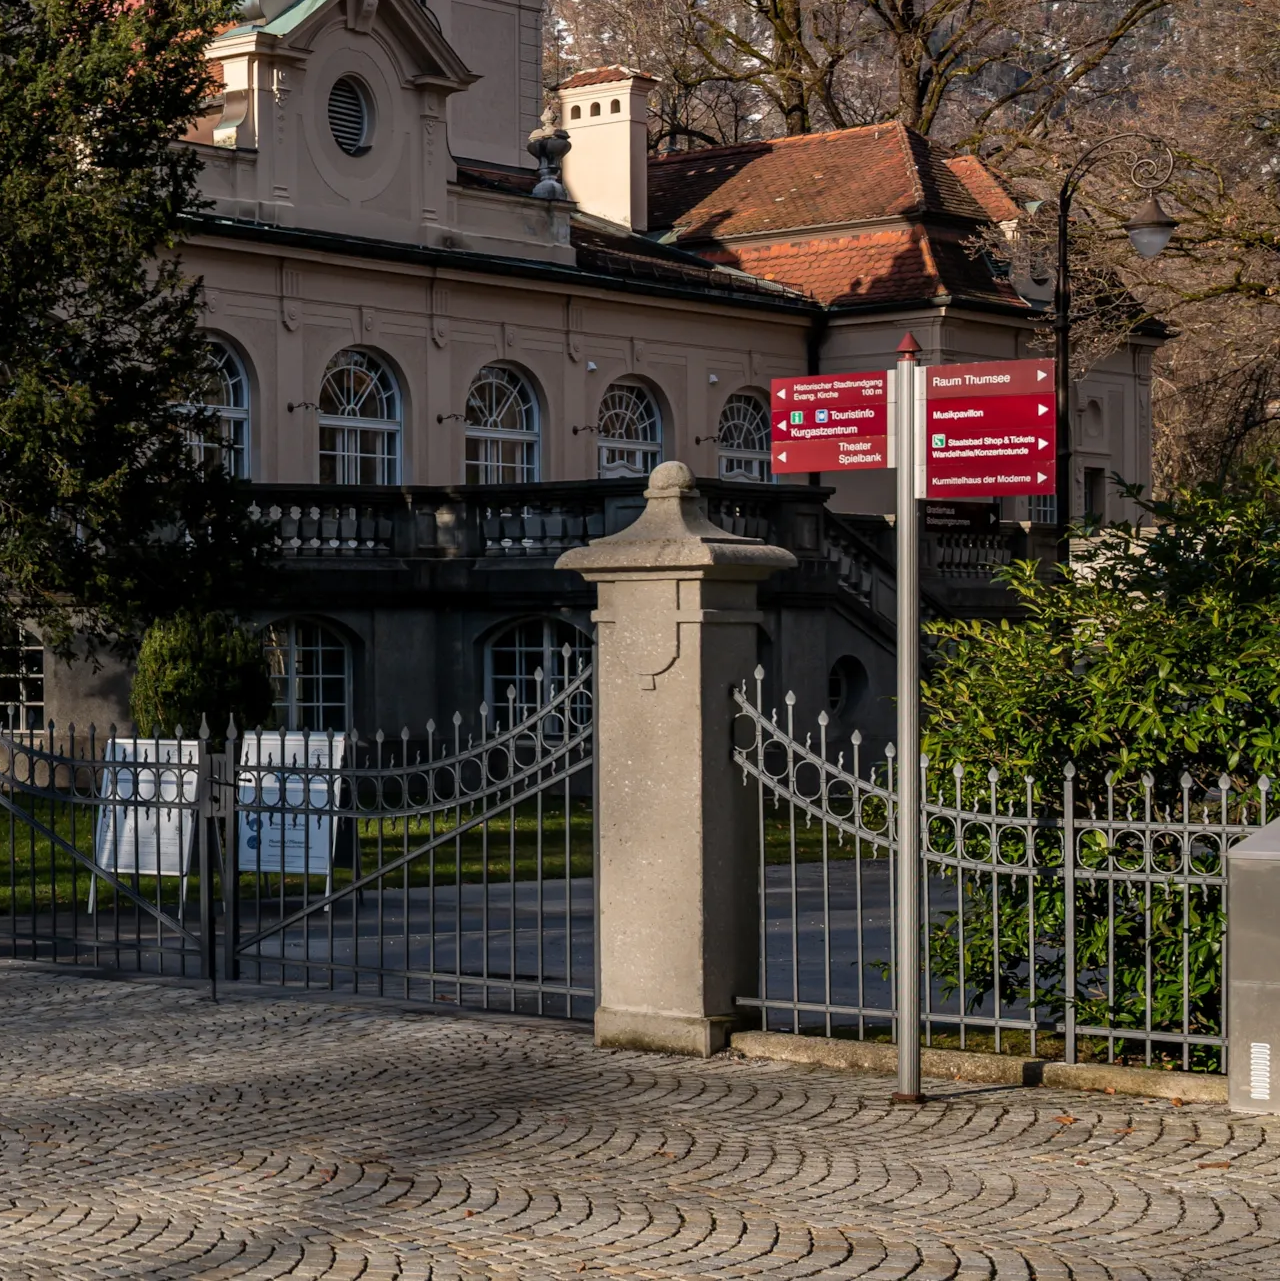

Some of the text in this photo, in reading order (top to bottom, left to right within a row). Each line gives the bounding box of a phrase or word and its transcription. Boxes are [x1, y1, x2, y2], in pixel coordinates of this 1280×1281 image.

[793, 379, 882, 391] Historischer Stadtrundgang
[933, 374, 1010, 387] Raum Thumsee
[794, 393, 816, 401] Evang.
[817, 391, 838, 399] Kirche
[830, 409, 874, 420] Touristinfo
[933, 409, 984, 420] Musikpavillon
[791, 426, 857, 438] Kurgastzentrum
[838, 442, 871, 451] Theater
[948, 435, 1035, 447] Staatsbad Shop & Tickets
[839, 453, 881, 465] Spielbank
[932, 447, 1029, 459] Wandelhalle/Konzertrotunde
[932, 474, 1031, 485] Kurmittelhaus der Moderne
